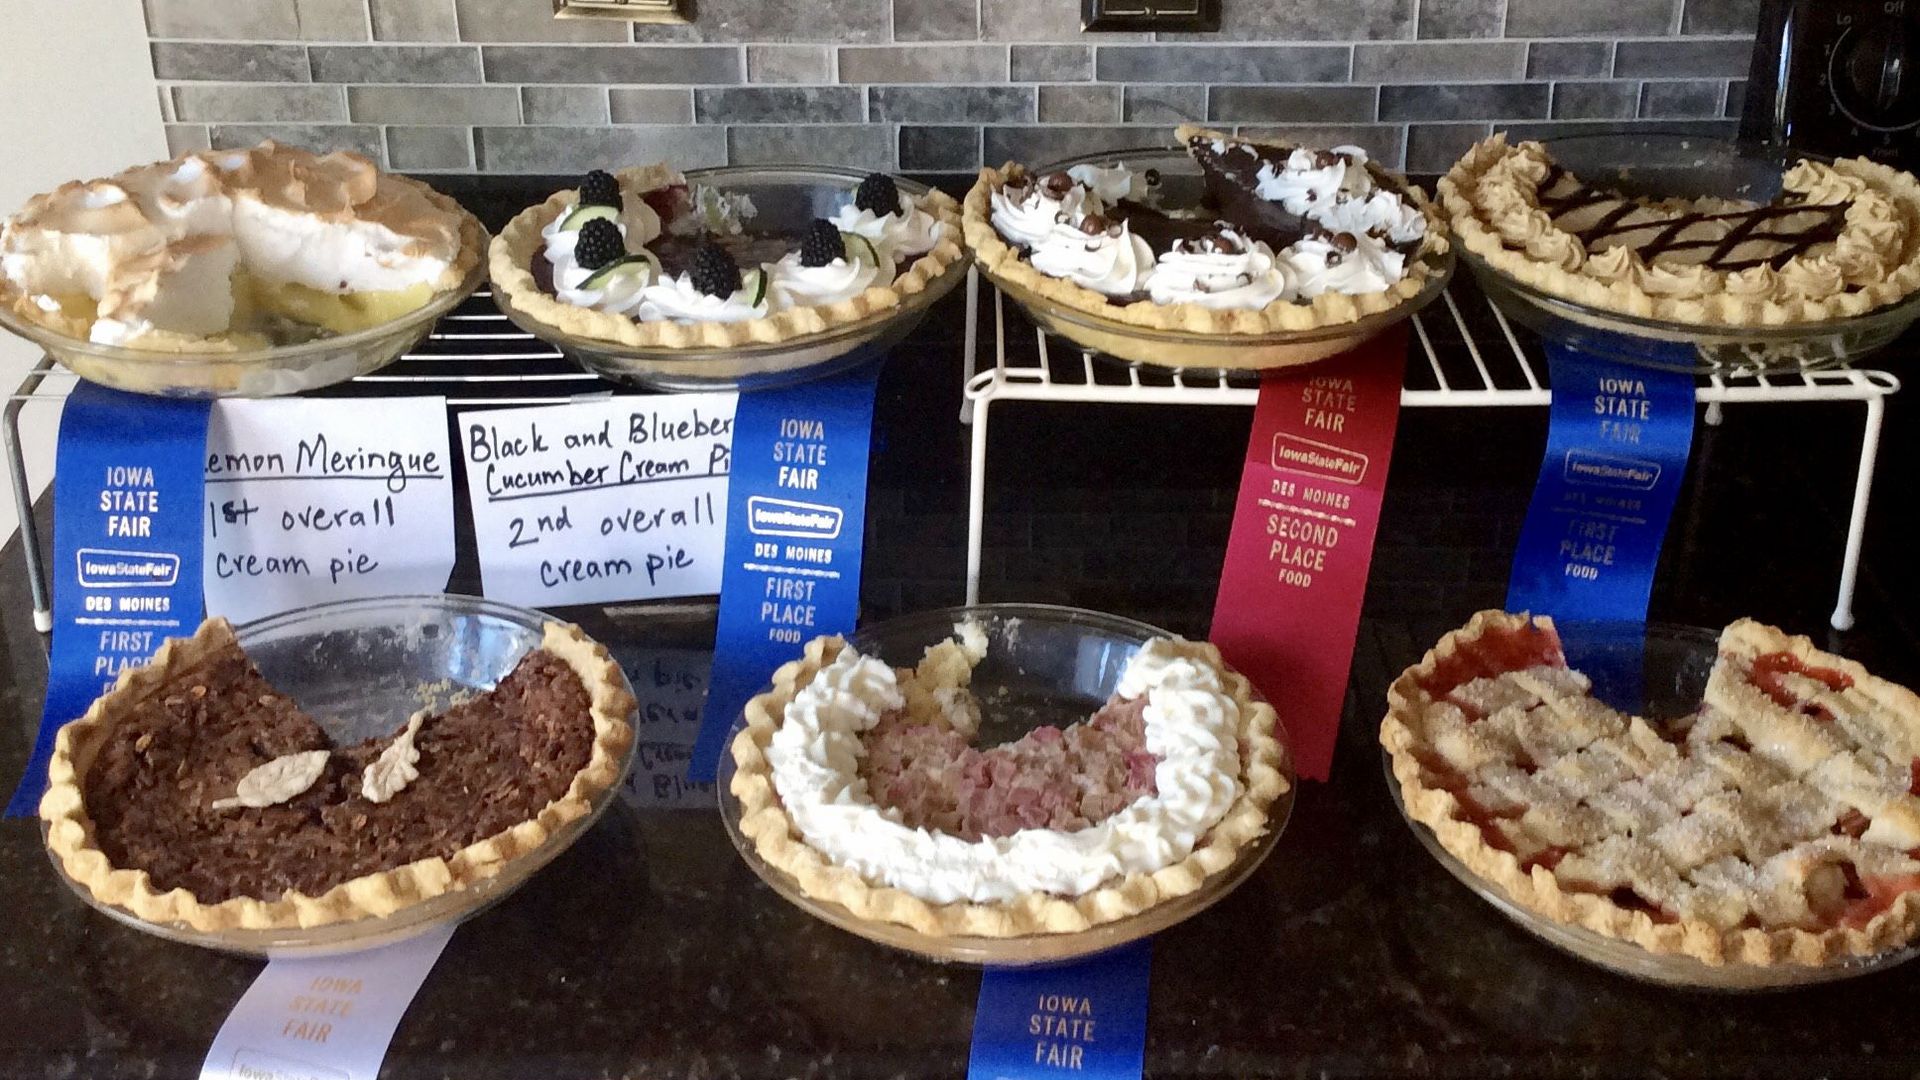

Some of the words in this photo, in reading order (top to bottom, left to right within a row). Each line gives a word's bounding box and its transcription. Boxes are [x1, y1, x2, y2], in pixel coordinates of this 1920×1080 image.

[1308, 375, 1354, 393] IOWA
[1599, 377, 1646, 396] IOWA
[1301, 387, 1357, 414] STATE
[1594, 394, 1651, 421] STATE
[779, 418, 825, 441] IOWA
[1304, 408, 1346, 434] FAIR
[1599, 420, 1642, 444] FAIR
[469, 421, 549, 463] Black
[564, 419, 614, 450] and
[627, 408, 734, 444] Blueber
[204, 450, 284, 475] emon
[296, 432, 441, 493] Meringue
[772, 442, 827, 466] STATE
[1278, 445, 1361, 476] IowaStateFair
[106, 466, 155, 487] IOWA
[486, 461, 609, 495] Cucumber
[618, 450, 690, 485] Cream
[708, 442, 731, 475] Pi
[778, 467, 818, 491] FAIR
[100, 490, 159, 513] STATE
[1271, 479, 1295, 498] DES
[1302, 486, 1351, 510] MOINES
[108, 515, 151, 538] FAIR
[209, 497, 259, 539] 1st
[281, 497, 395, 532] overall
[508, 505, 573, 549] 2nd
[599, 492, 715, 538] overall
[1266, 513, 1339, 548] SECOND
[754, 543, 778, 560] DES
[785, 545, 832, 564] MOINES
[1269, 540, 1325, 572] PLACE
[1559, 539, 1616, 565] PLACE
[85, 561, 173, 578] IowaStateFair
[330, 548, 380, 584] pie
[646, 544, 695, 588] pie
[1278, 568, 1312, 588] FOOD
[1565, 562, 1599, 581] FOOD
[765, 577, 816, 602] FIRST
[86, 597, 112, 612] DES
[120, 597, 170, 612] MOINES
[760, 600, 816, 627] PLACE
[100, 631, 153, 652] FIRST
[768, 629, 801, 644] FOOD
[310, 975, 364, 994] IOWA
[1037, 993, 1092, 1017] IOWA
[282, 1018, 334, 1044] FAIR
[1028, 1013, 1097, 1042] STATE
[1034, 1040, 1084, 1071] FAIR
